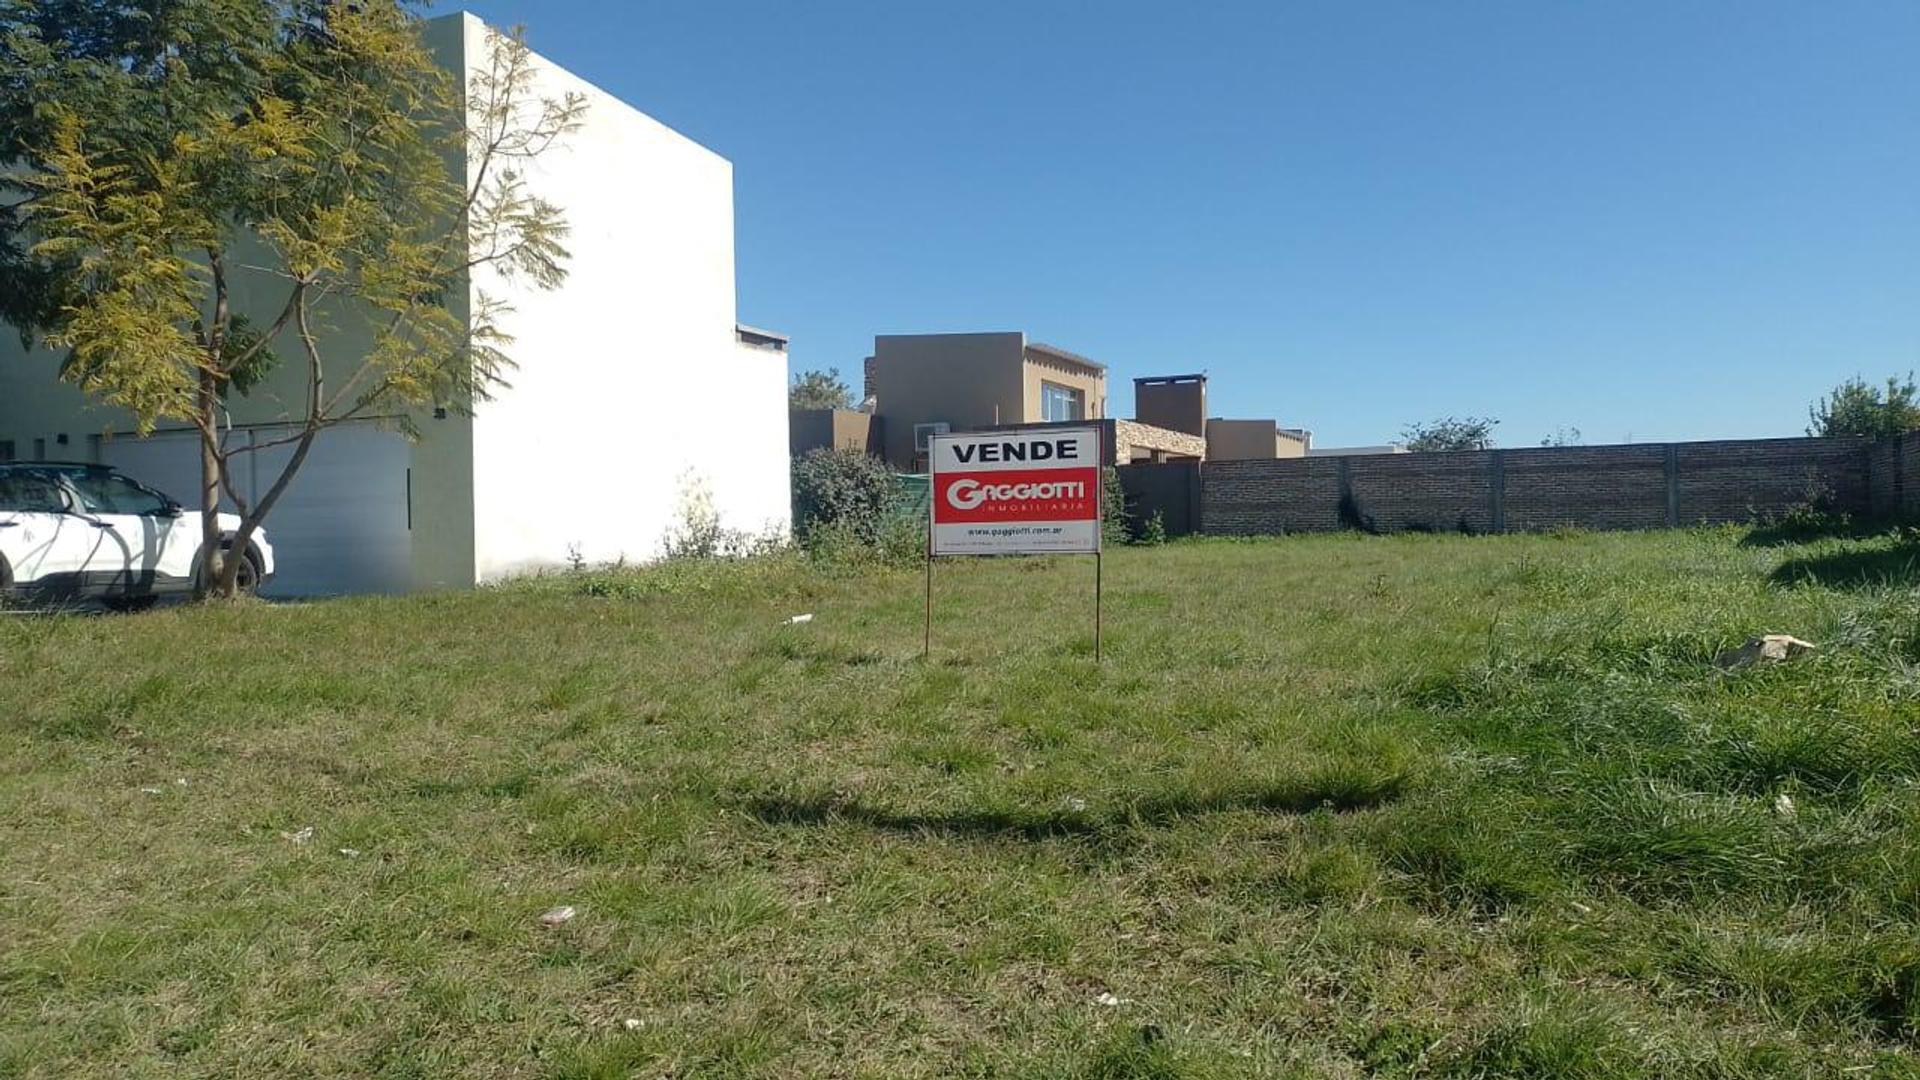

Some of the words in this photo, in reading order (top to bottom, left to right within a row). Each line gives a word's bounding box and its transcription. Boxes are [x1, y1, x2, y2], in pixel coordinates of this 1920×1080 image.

[952, 440, 1078, 463] VENDE
[946, 478, 1085, 510] GAGGIOTTI
[983, 502, 1085, 513] INMOBILIARIA
[968, 527, 1063, 538] www.gaggiotti.com.ar
